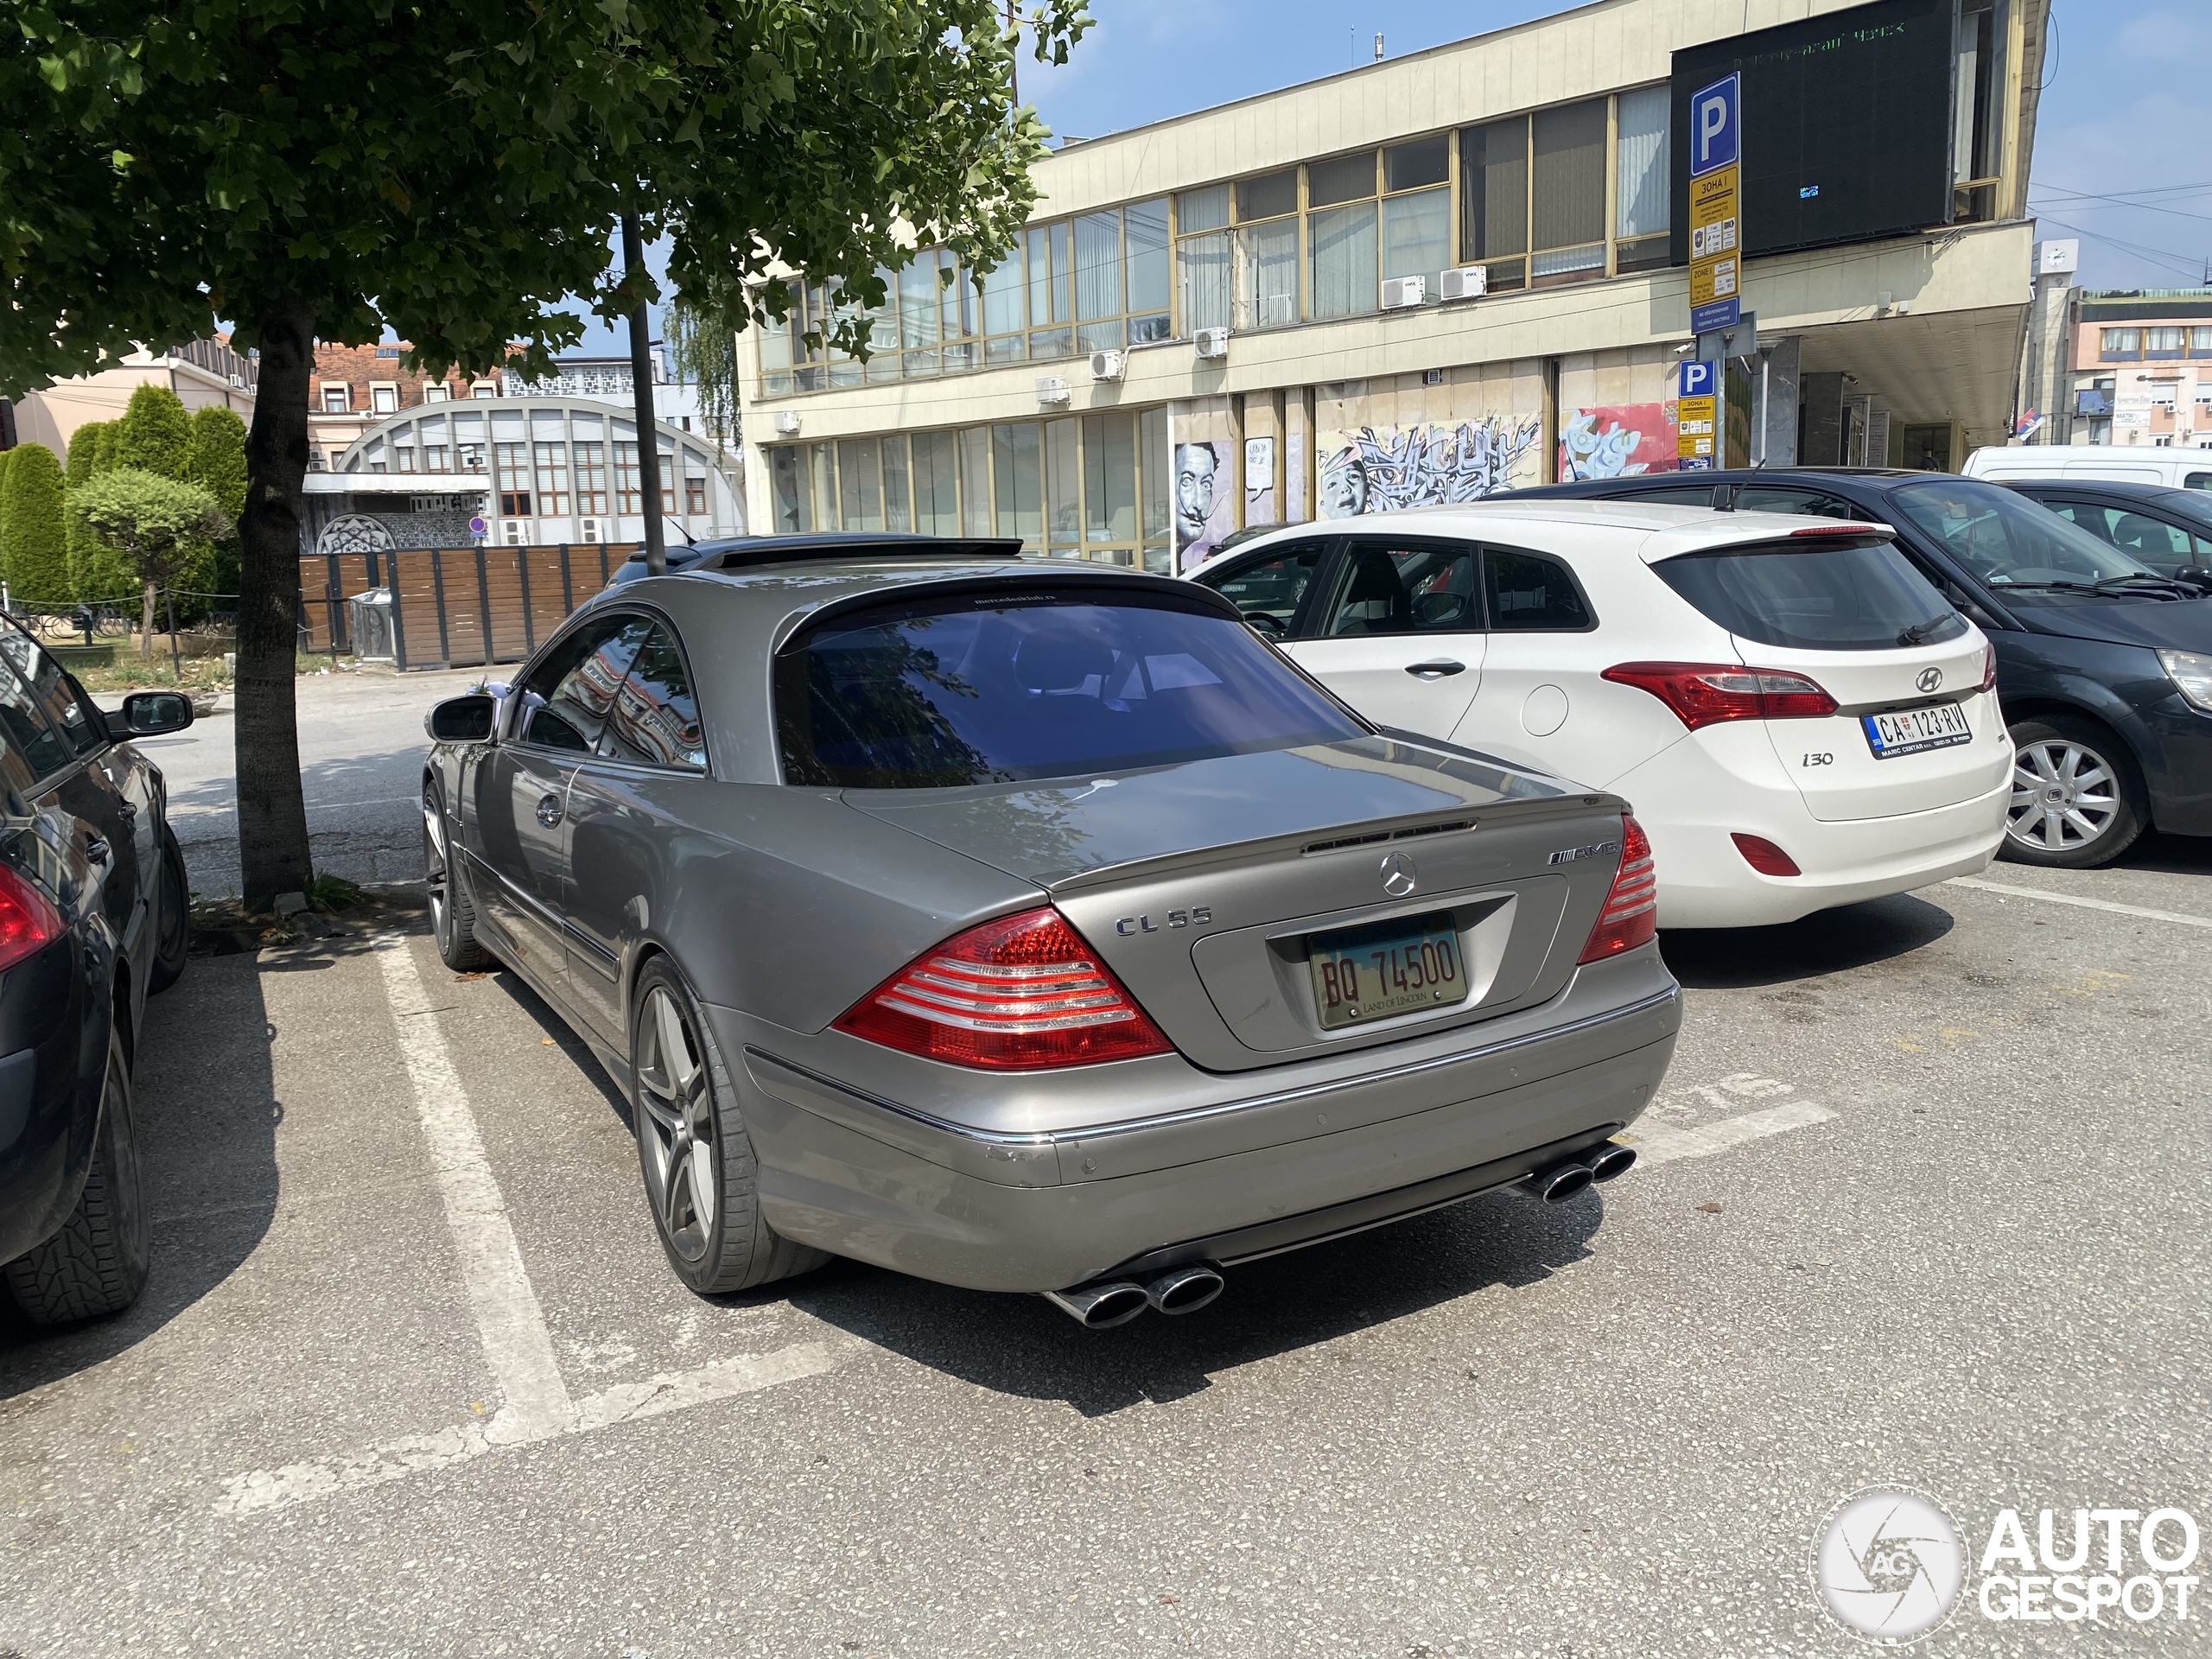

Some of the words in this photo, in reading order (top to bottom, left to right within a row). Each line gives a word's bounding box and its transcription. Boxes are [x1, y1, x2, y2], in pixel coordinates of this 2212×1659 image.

[1701, 96, 1727, 162] P
[1701, 178, 1723, 194] ЗОНА
[1694, 268, 1708, 278] ZONE
[1687, 364, 1707, 392] P
[974, 594, 1056, 605] mercedesklub.rs
[1879, 716, 1906, 743] ČA
[1902, 743, 1924, 753] CENTAR
[1802, 753, 1834, 767] i30
[1573, 840, 1618, 861] AMG
[1116, 914, 1159, 937] CL
[1167, 906, 1212, 929] 55
[1321, 957, 1359, 1008] BQ
[1370, 939, 1455, 996] 74500
[1363, 1001, 1385, 1014] LAND
[1385, 997, 1396, 1008] OF
[1396, 991, 1427, 1007] LINCOLN
